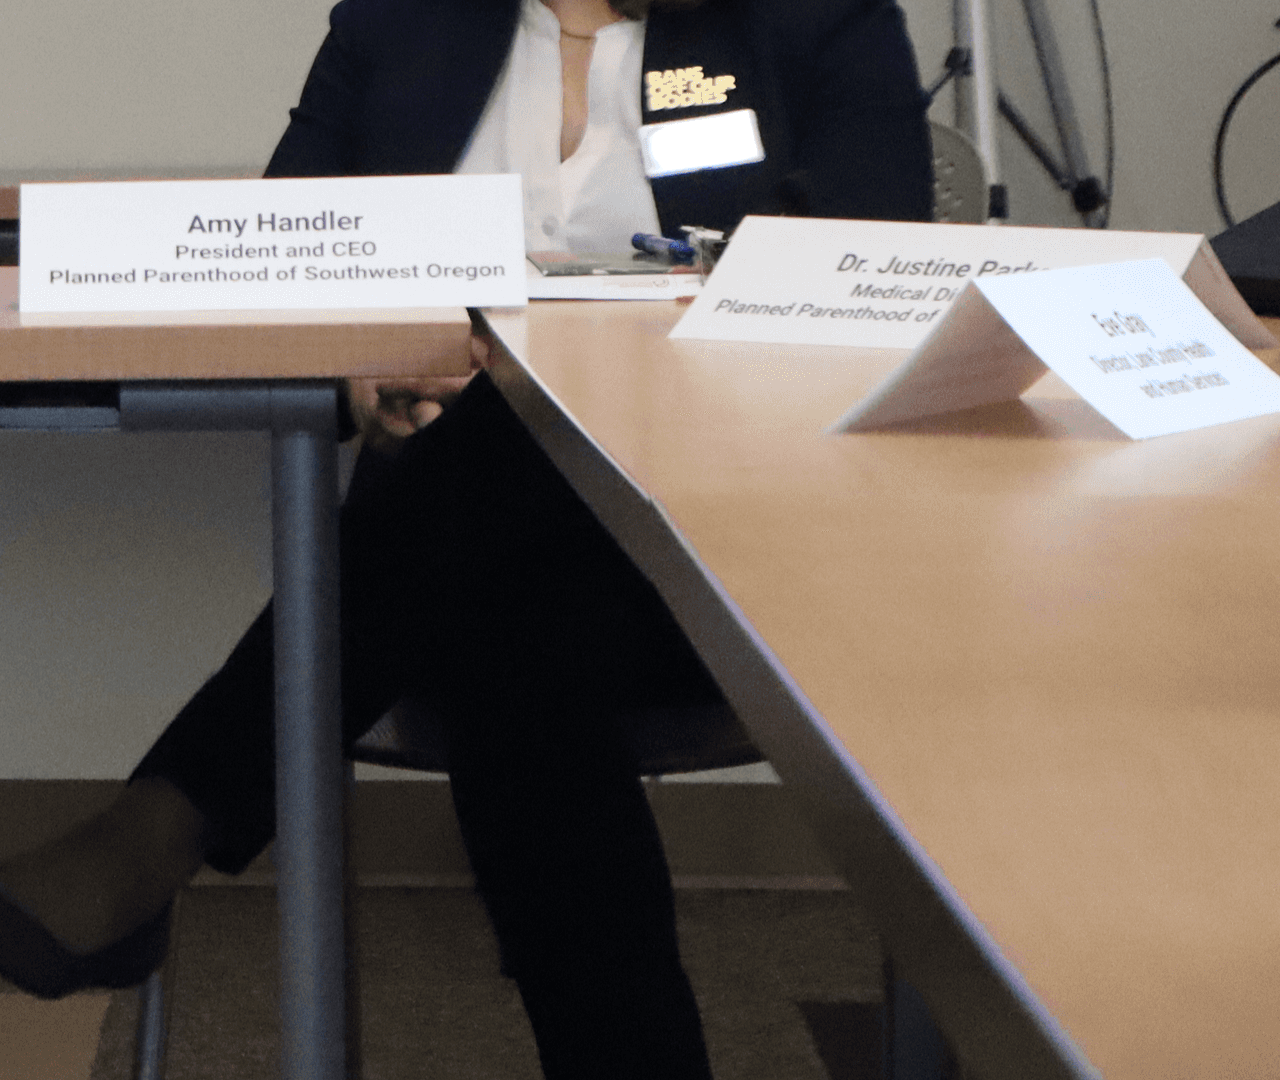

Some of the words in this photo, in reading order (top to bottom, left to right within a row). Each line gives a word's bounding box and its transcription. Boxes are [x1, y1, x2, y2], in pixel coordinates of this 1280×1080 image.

[188, 214, 248, 237] Amy
[257, 210, 364, 232] Handler
[175, 243, 279, 260] President
[286, 242, 324, 258] and
[332, 240, 377, 257] CEO
[49, 269, 136, 284] Planned
[143, 267, 268, 283] Parenthood
[275, 265, 298, 281] of
[305, 263, 419, 281] Southwest
[426, 262, 505, 281] Oregon
[836, 253, 868, 273] Dr.
[877, 256, 972, 278] Justine
[977, 260, 1051, 277] Park
[849, 283, 932, 302] Medical
[713, 299, 795, 317] Planned
[796, 303, 914, 322] Parenthood
[915, 309, 942, 323] of
